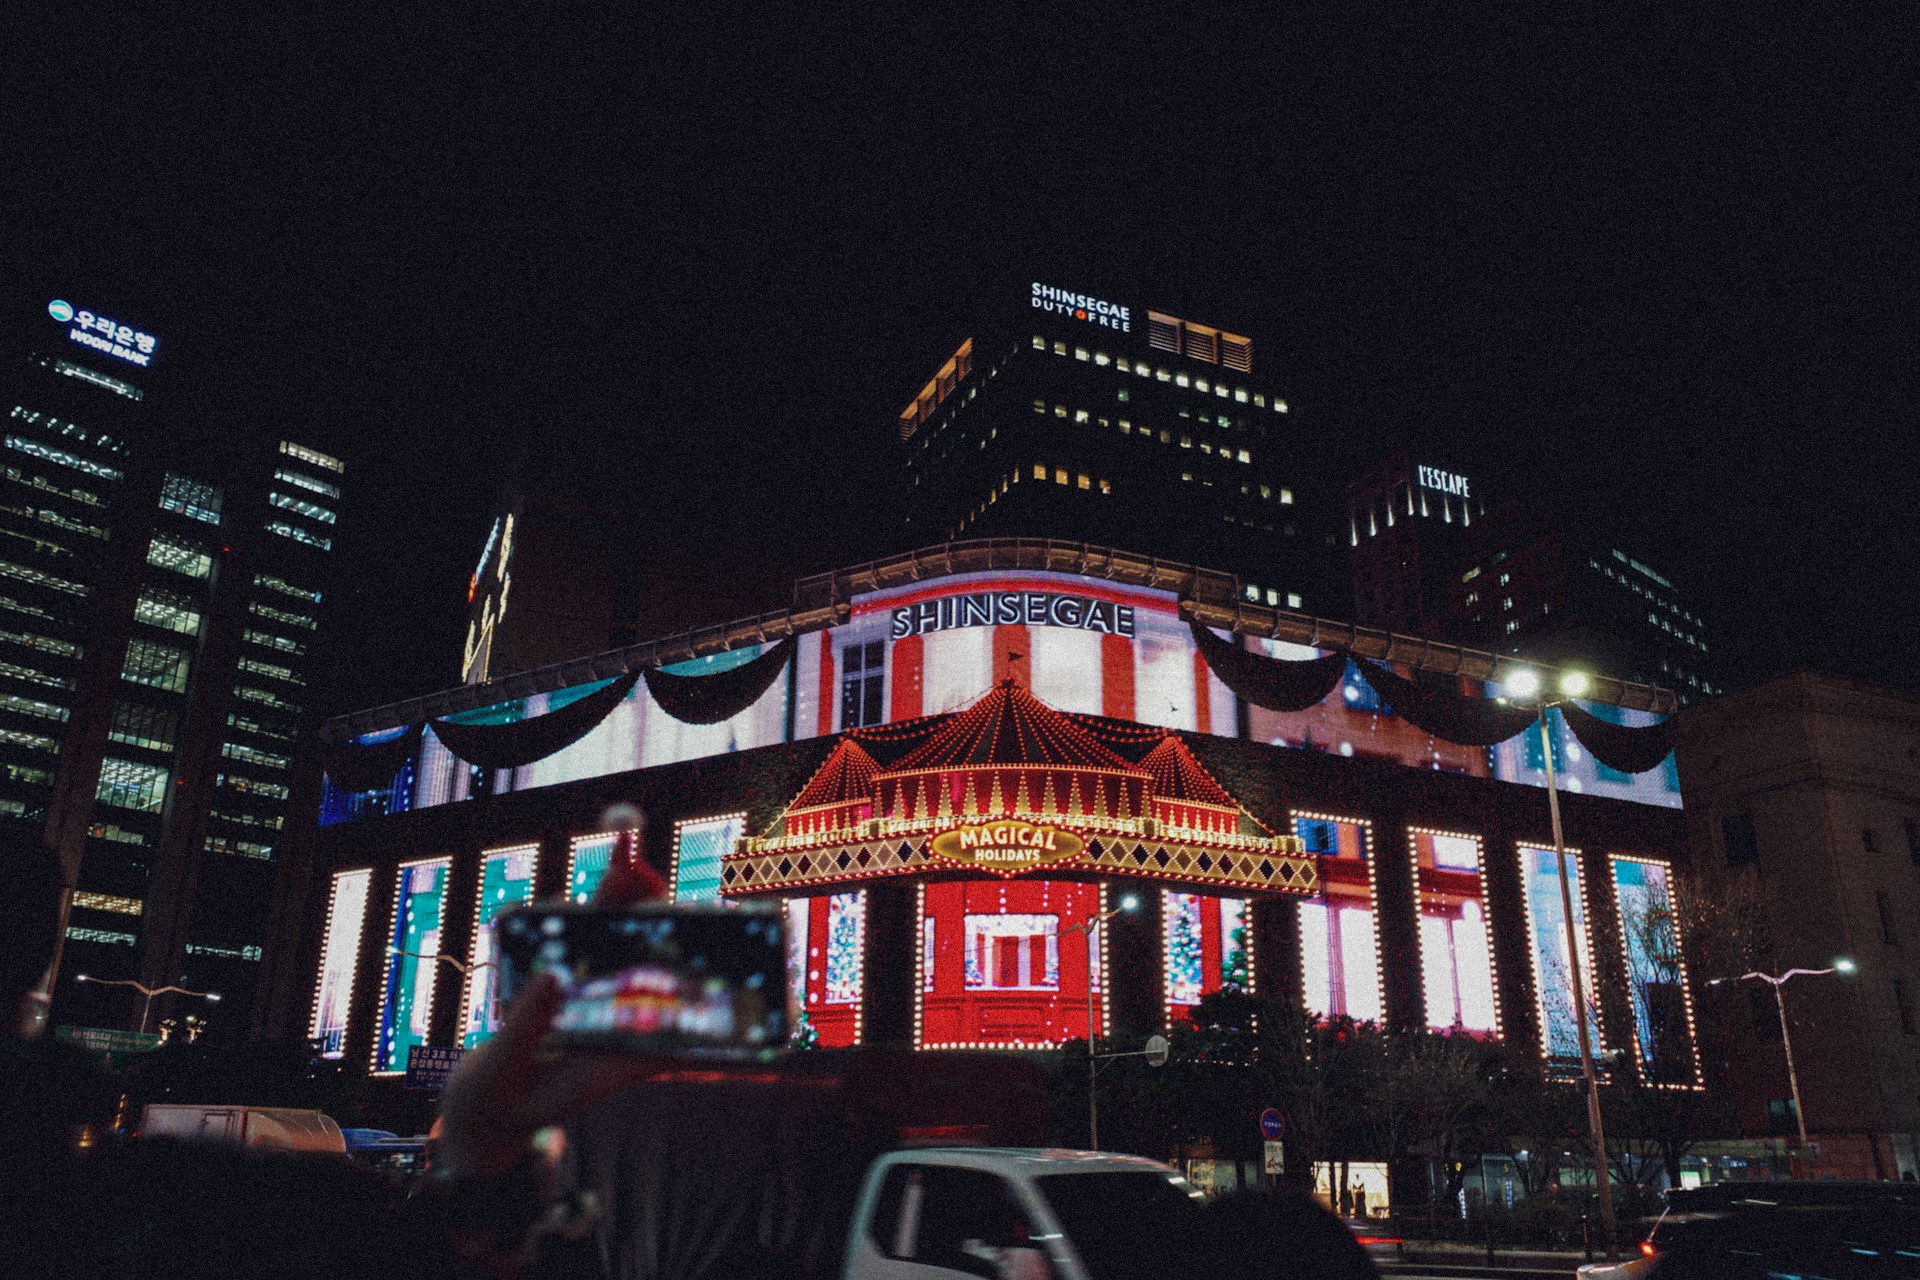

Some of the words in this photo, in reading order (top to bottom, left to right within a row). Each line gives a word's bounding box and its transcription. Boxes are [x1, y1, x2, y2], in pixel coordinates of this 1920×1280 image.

[1031, 282, 1130, 321] SHINSEGAE
[1031, 297, 1075, 317] DUTY
[1087, 312, 1131, 333] FREE
[70, 328, 114, 353] WOORI
[111, 344, 150, 367] BANK
[74, 310, 155, 353] 우리은행
[1418, 464, 1471, 498] L'ESCAPE
[892, 592, 1135, 640] SHINSEGAE
[960, 826, 1057, 851] MAGICAL
[974, 849, 1041, 861] HOLIDAYS
